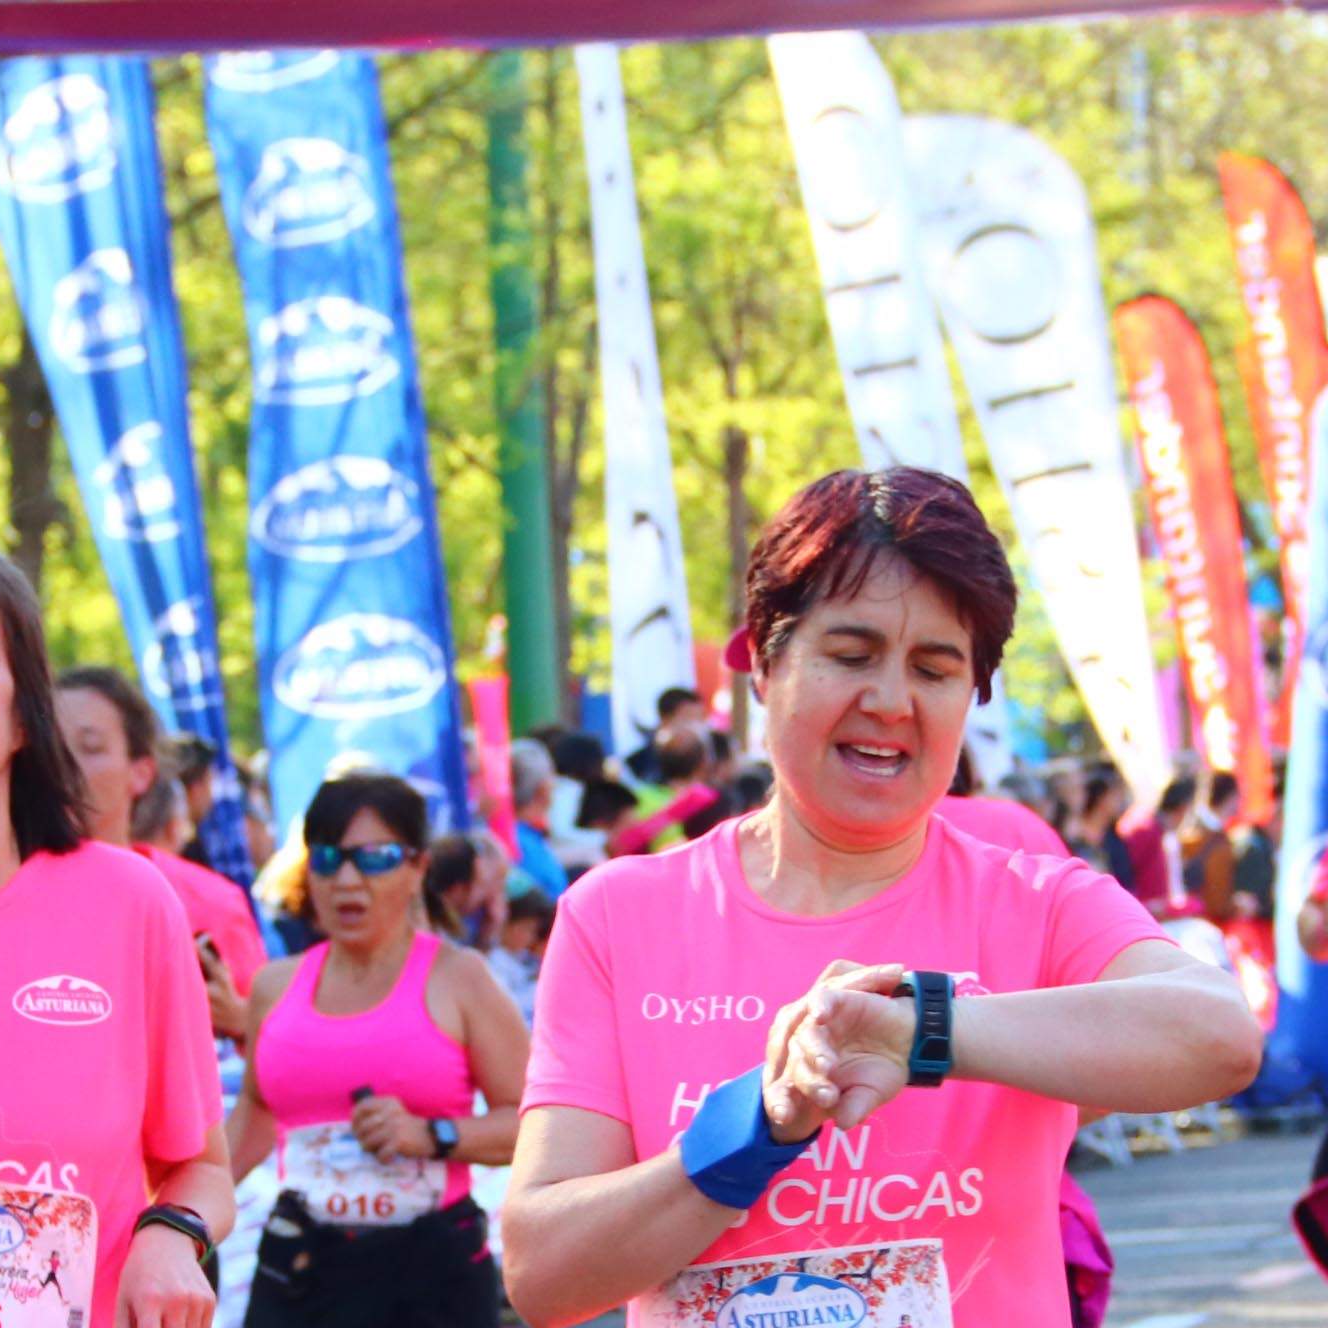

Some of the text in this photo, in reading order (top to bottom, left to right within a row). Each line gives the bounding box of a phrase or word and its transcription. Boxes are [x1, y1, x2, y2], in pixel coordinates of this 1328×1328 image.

[20, 991, 106, 1014] ASTURIANA
[641, 993, 765, 1025] OYSHO
[327, 1193, 397, 1218] 016
[767, 1167, 984, 1227] CHICAS
